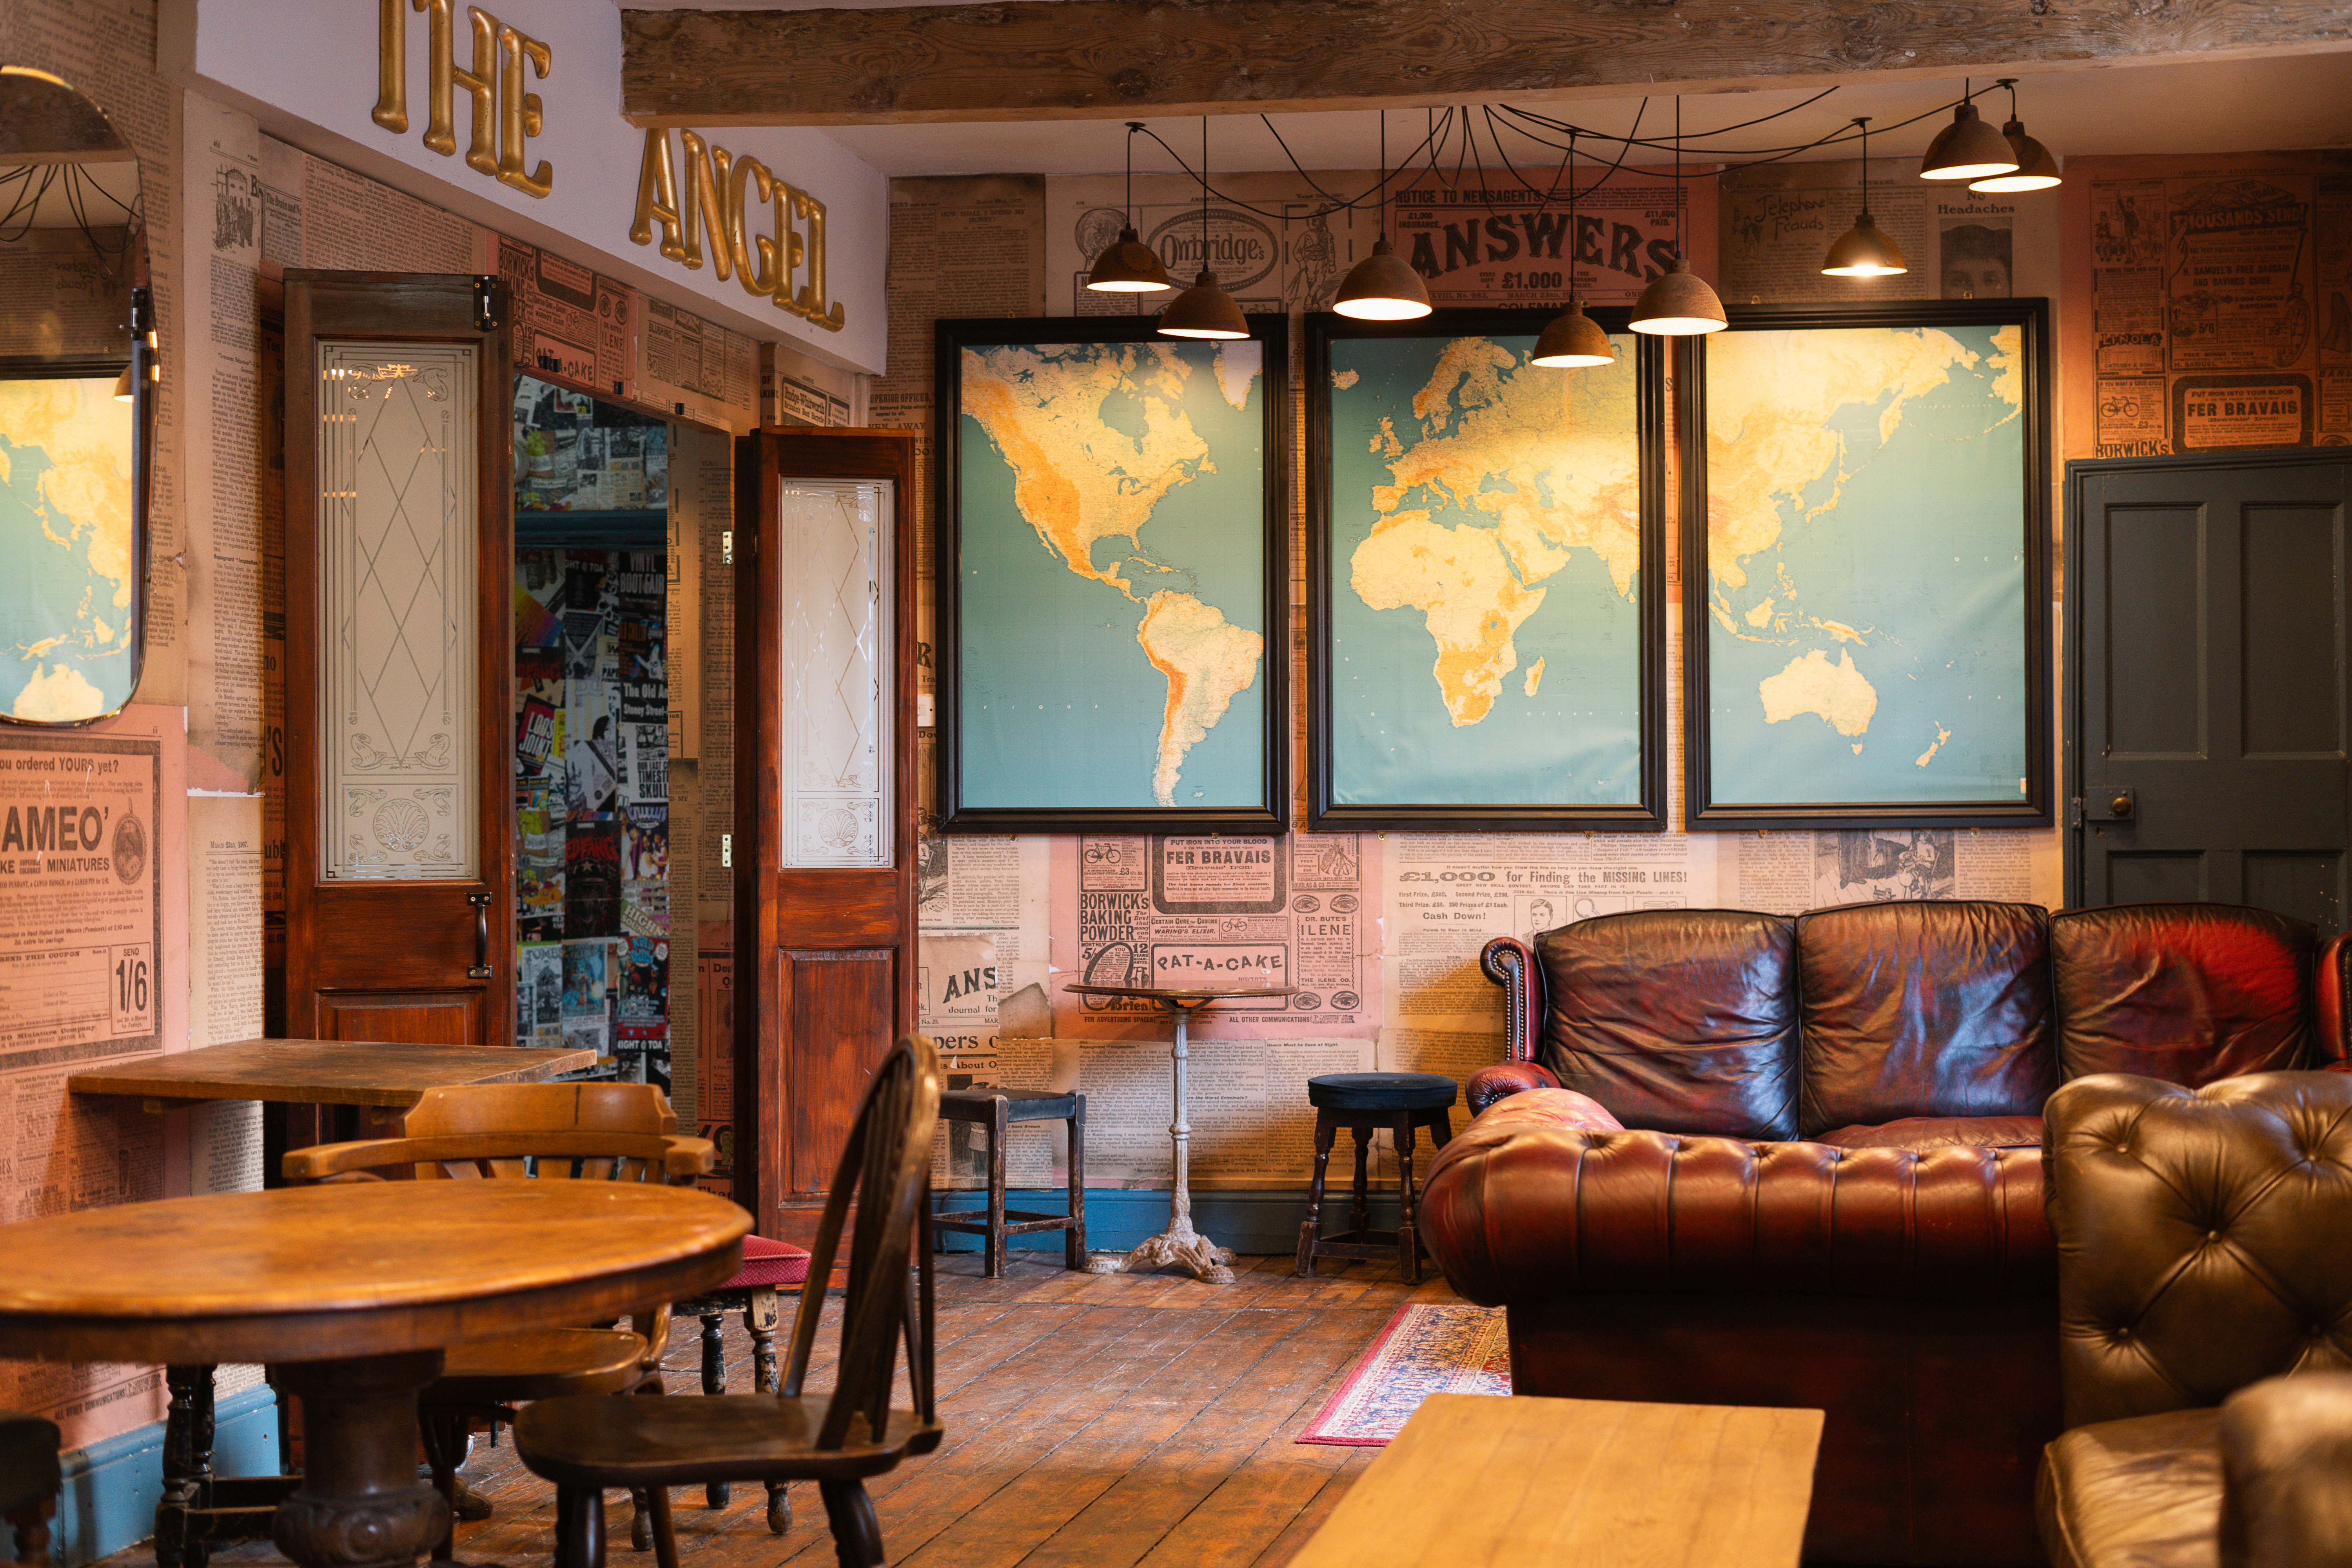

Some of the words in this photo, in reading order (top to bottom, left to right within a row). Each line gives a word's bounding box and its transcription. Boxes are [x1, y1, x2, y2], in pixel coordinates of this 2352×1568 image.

[372, 0, 552, 198] THE
[275, 196, 287, 209] Brain
[1396, 190, 1439, 204] NOTICE
[1443, 190, 1457, 203] TO
[1463, 189, 1544, 203] NEWSAGENTS.
[1967, 191, 1985, 200] No
[1756, 194, 1826, 223] Telephone
[1937, 204, 2015, 215] Headaches
[2174, 211, 2261, 230] THOUSANDS
[2267, 205, 2304, 223] SEND!
[629, 129, 844, 332] ANGEL
[1774, 216, 1824, 241] Frauds
[1412, 212, 1677, 283] ANSWERS
[2183, 267, 2190, 276] H.
[2194, 266, 2232, 275] SAMUEL'S
[2236, 265, 2254, 274] FREE
[2258, 264, 2290, 273] BARGAIN
[1502, 272, 1562, 289] £1,000
[2193, 278, 2208, 287] AND
[2213, 277, 2245, 286] SAVINGS
[2249, 276, 2271, 285] GUIDE
[2102, 334, 2159, 345] LINOLA
[762, 376, 771, 384] OF
[870, 394, 898, 403] UPERIOR
[2188, 403, 2217, 417] FER
[2225, 400, 2298, 416] BRAVAIS
[630, 553, 656, 572] VINYL
[620, 573, 643, 593] BOOT
[643, 574, 664, 594] FAIR
[624, 682, 639, 697] The
[642, 684, 656, 698] Old
[0, 760, 11, 769] ou
[16, 757, 54, 770] ordered
[59, 757, 94, 771] YOURS
[98, 759, 118, 775] yet?
[2, 806, 108, 851] AMEO'
[1167, 851, 1194, 864] FER
[1201, 850, 1271, 864] BRAVAIS
[47, 858, 109, 872] MINIATURES
[1399, 872, 1495, 884] £1,000
[1506, 871, 1523, 882] for
[1530, 871, 1570, 884] Finding
[1578, 871, 1596, 882] the
[1603, 871, 1646, 883] MISSING
[1653, 871, 1687, 882] LINES!
[1080, 910, 1131, 925] BAKING
[1080, 926, 1136, 941] POWDER.
[1301, 925, 1350, 935] ILENE
[123, 948, 139, 956] SEND
[1133, 943, 1148, 953] 12
[1157, 955, 1283, 971] PAT-A-CAKE
[116, 959, 147, 1013] 1/6
[1111, 1001, 1149, 1011] Brien
[18, 1030, 56, 1040] Miniature
